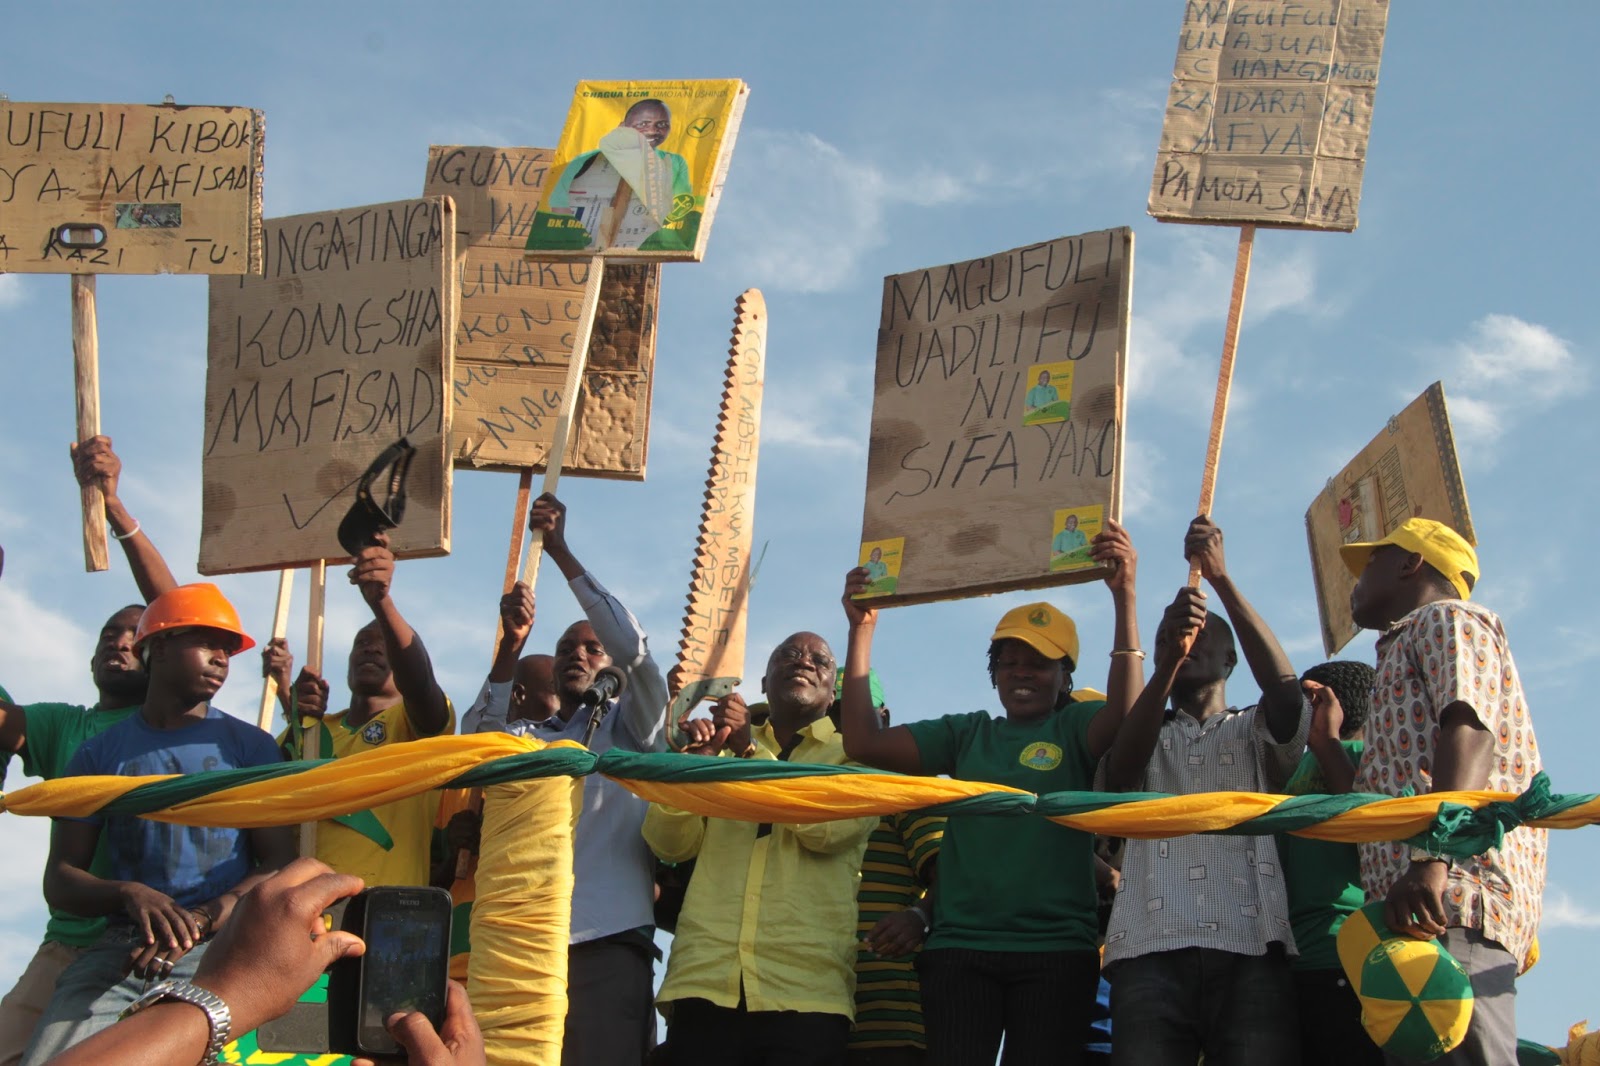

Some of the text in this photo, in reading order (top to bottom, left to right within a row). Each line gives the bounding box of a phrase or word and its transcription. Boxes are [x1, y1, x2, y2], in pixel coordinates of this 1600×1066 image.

[626, 90, 650, 98] CCM
[1173, 90, 1213, 112] ZA
[1223, 89, 1306, 115] IDARA
[1191, 122, 1309, 155] AFYA
[41, 227, 124, 268] KAZI
[240, 202, 444, 288] INGATINGA
[889, 232, 1113, 330] MAGUFULI
[235, 287, 442, 369] KOMESHA
[742, 329, 761, 386] CCM
[895, 302, 1102, 388] UADILIFU
[206, 364, 444, 456] MAFISADI
[733, 395, 755, 484] MBELE
[960, 371, 1020, 426] NI
[709, 451, 733, 514] HAPA
[885, 418, 1117, 505] SIFA YAKO
[713, 546, 740, 646] MBELE
